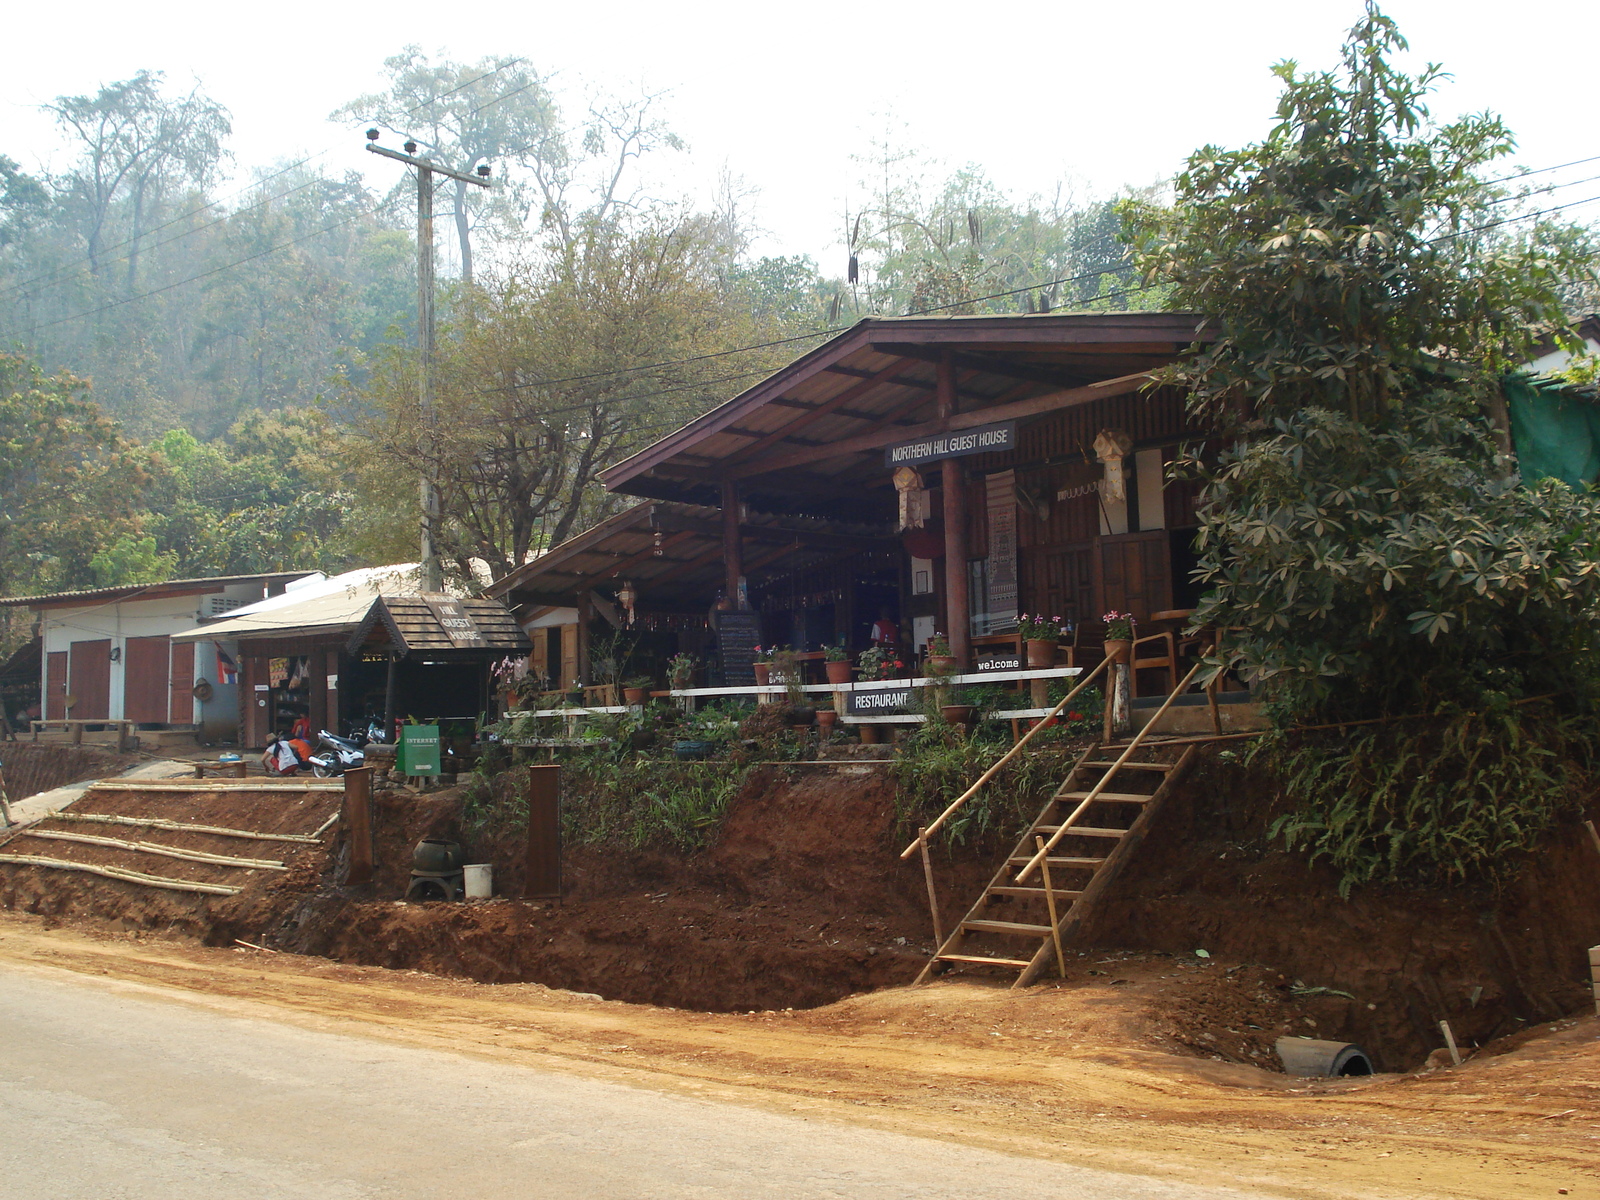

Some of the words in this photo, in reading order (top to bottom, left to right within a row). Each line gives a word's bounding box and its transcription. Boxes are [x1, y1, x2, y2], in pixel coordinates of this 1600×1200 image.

[892, 441, 933, 462] NORTHERN
[933, 439, 949, 455] HILL
[949, 434, 978, 452] GUEST
[979, 429, 1008, 447] HOUSE
[439, 605, 458, 615] HILL
[441, 618, 471, 628] GUEST
[449, 631, 481, 640] HOUSE
[978, 659, 1019, 670] welcome
[855, 692, 908, 709] RESTAURANT
